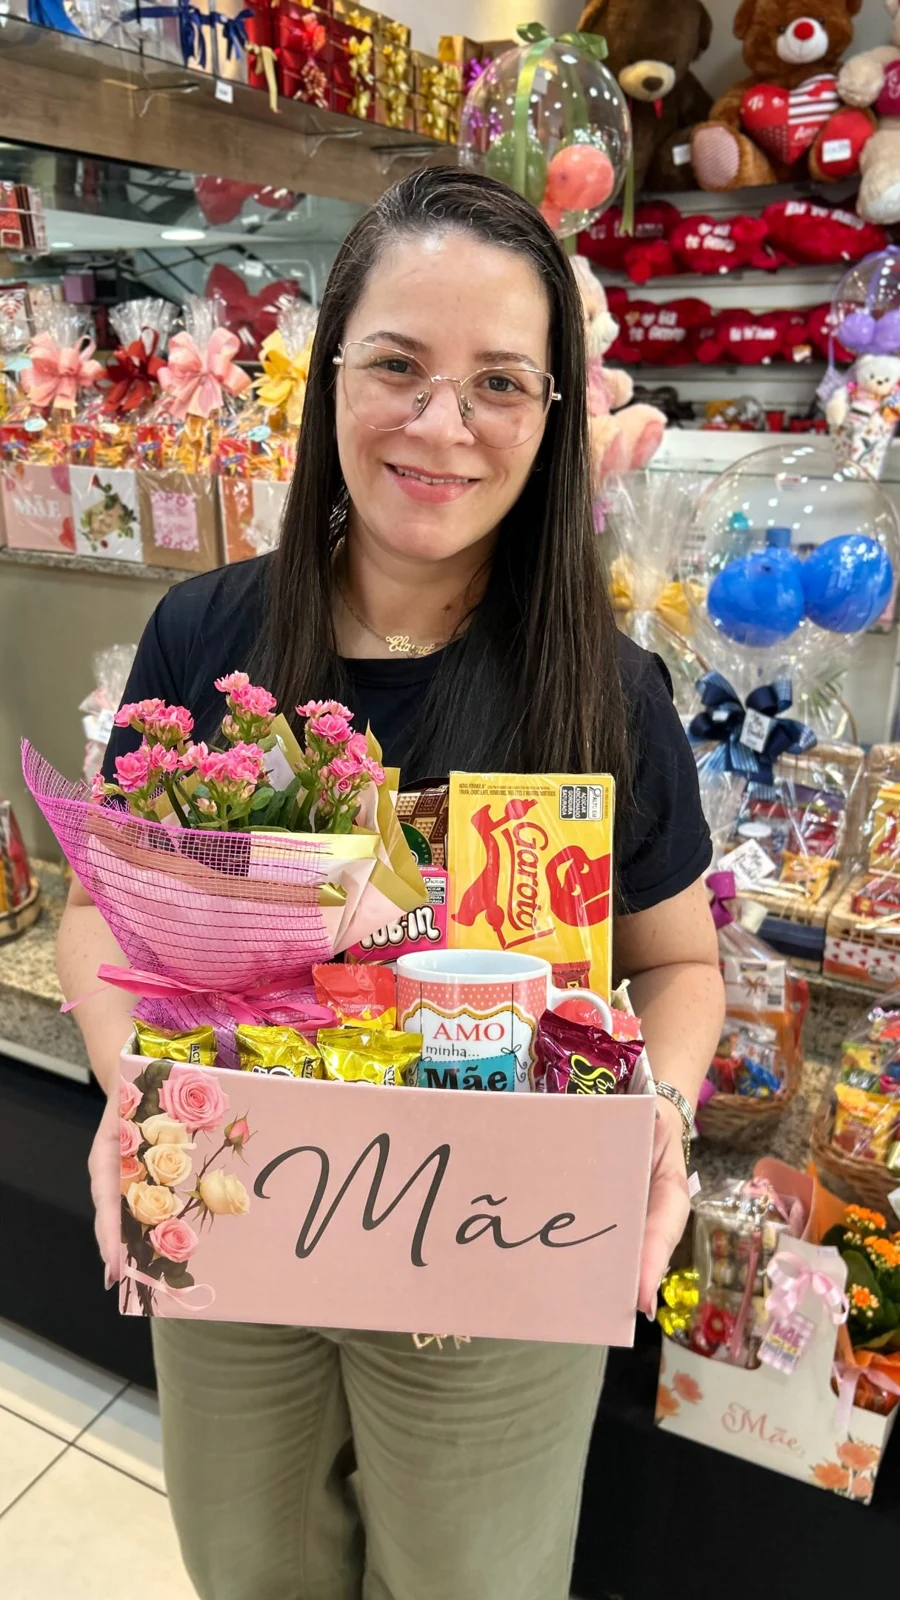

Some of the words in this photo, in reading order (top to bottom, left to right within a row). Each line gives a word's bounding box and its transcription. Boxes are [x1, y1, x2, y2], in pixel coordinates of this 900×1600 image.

[513, 822, 548, 928] Garoto
[432, 1022, 505, 1041] AMO
[423, 1064, 508, 1091] Mãe
[253, 1132, 618, 1267] Mãe
